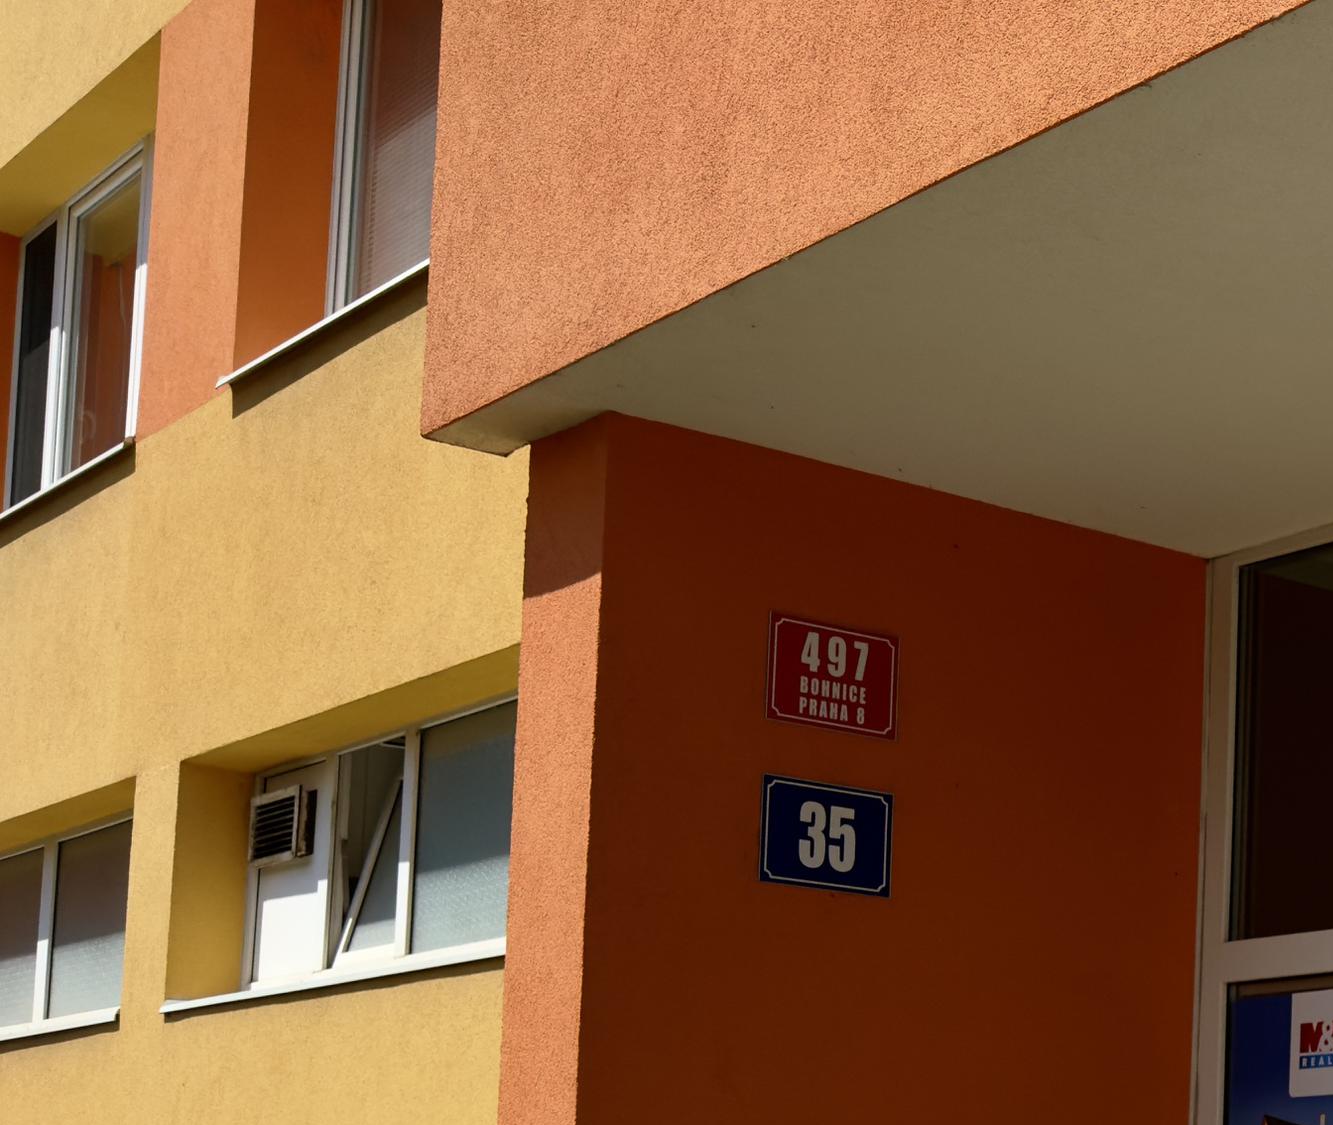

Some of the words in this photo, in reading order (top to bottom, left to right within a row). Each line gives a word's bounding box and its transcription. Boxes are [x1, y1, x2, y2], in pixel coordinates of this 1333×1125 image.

[801, 631, 869, 681] 497
[799, 675, 866, 705] BOHNICE
[799, 696, 848, 722] PRAHA
[856, 707, 865, 725] 8
[798, 800, 856, 873] 35
